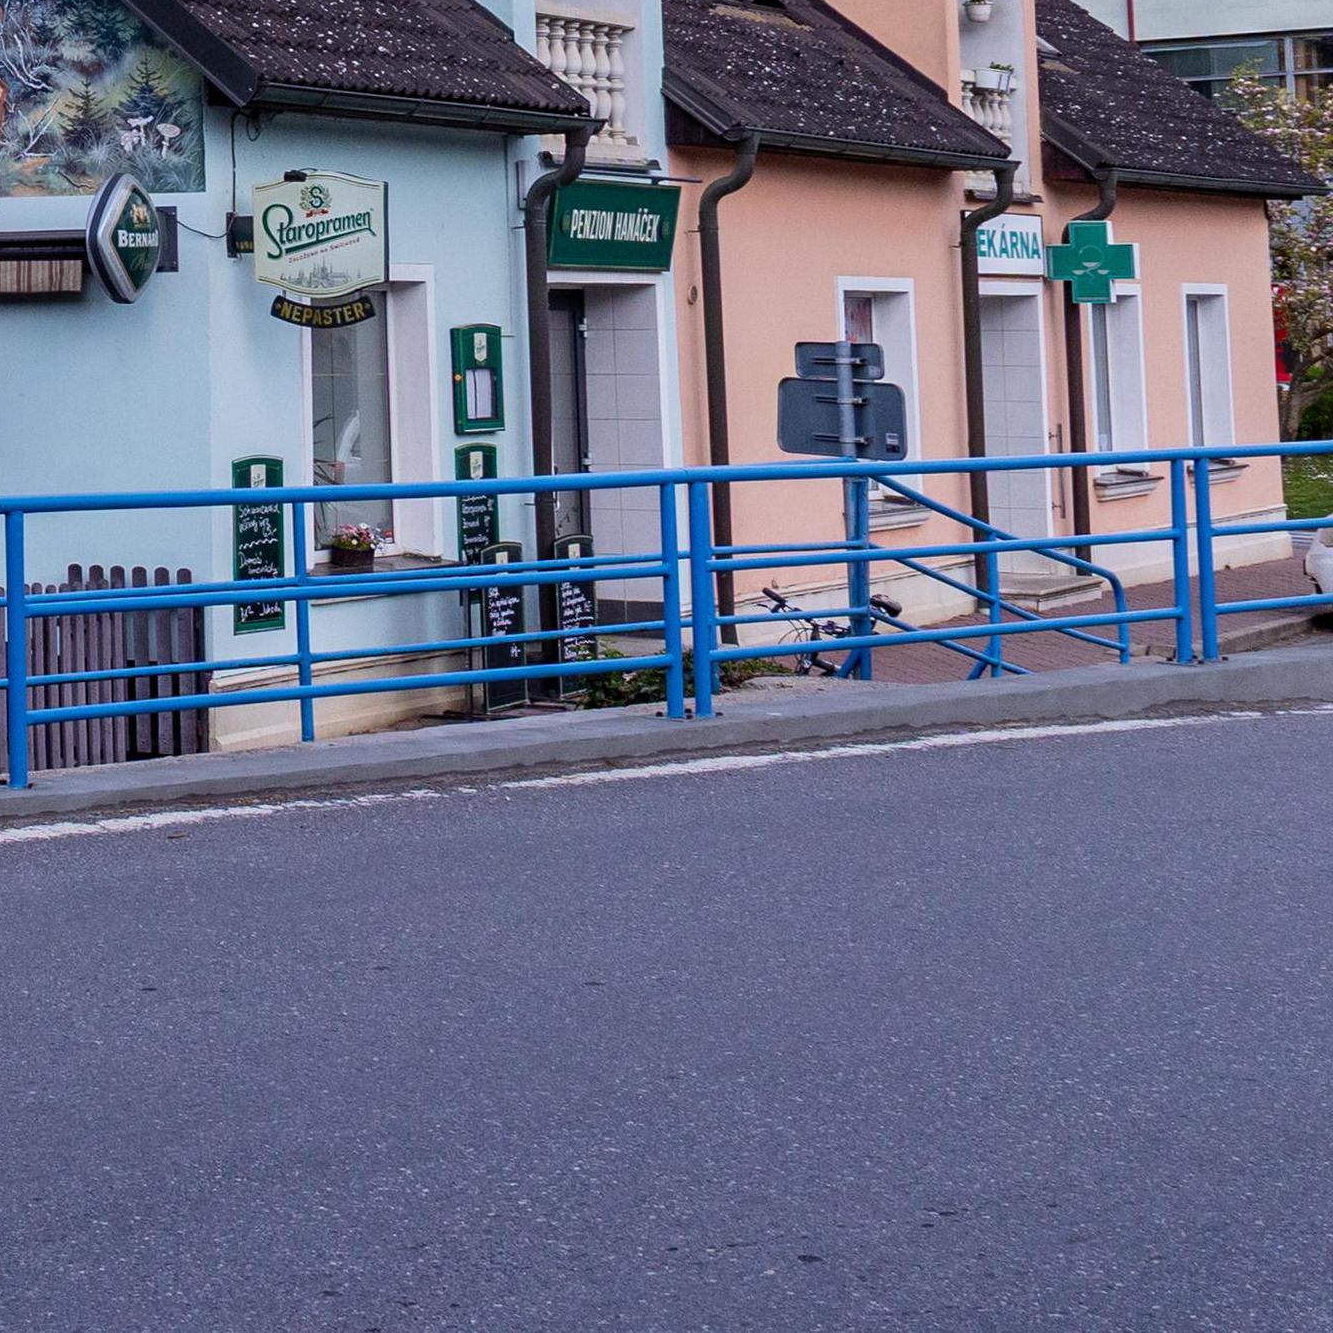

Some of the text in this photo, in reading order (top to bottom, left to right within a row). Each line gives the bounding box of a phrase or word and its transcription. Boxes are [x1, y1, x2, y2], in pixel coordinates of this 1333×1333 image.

[262, 204, 376, 259] Staropramen
[570, 207, 660, 242] PENZION HANÁČEK
[977, 223, 1041, 259] EKÁRNA
[280, 301, 366, 325] NEPASTER
